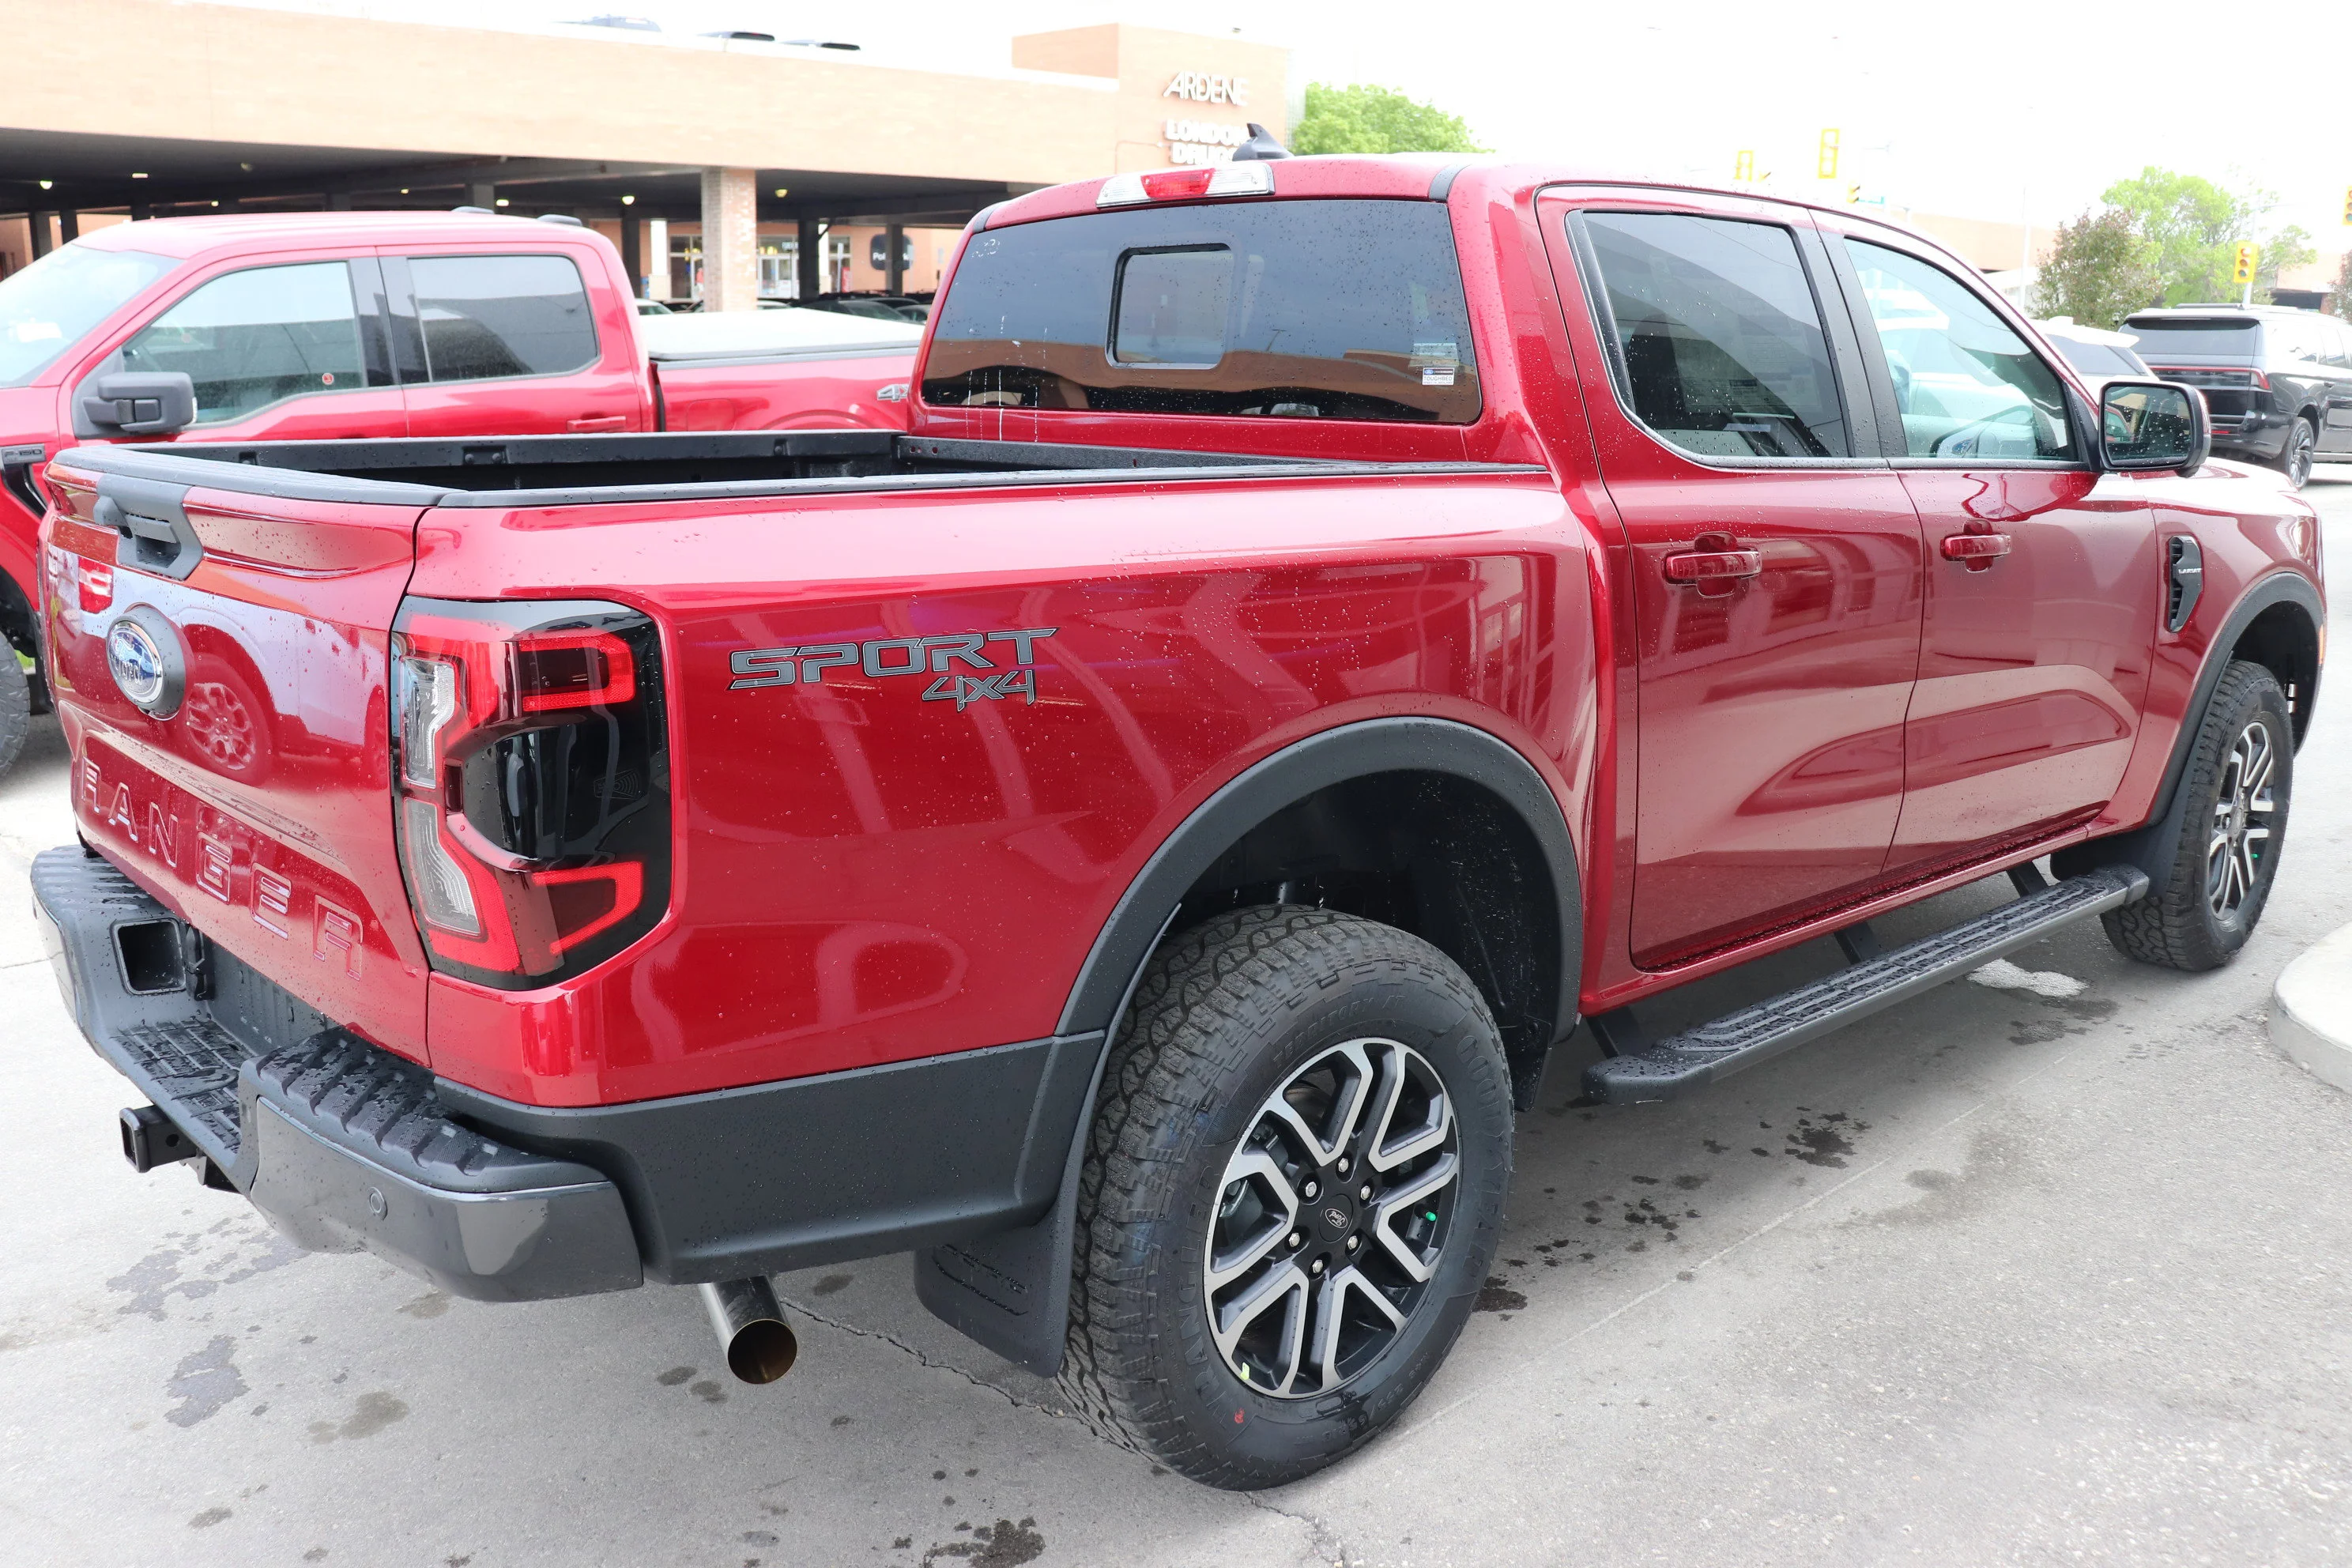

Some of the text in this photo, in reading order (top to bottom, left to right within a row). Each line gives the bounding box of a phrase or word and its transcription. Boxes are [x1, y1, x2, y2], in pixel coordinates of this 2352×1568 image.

[1163, 72, 1249, 107] ARDENE
[1165, 119, 1251, 148] LONDON
[726, 628, 1060, 692] SPORT
[81, 756, 364, 982] RANGER
[1328, 1210, 1347, 1227] Ford
